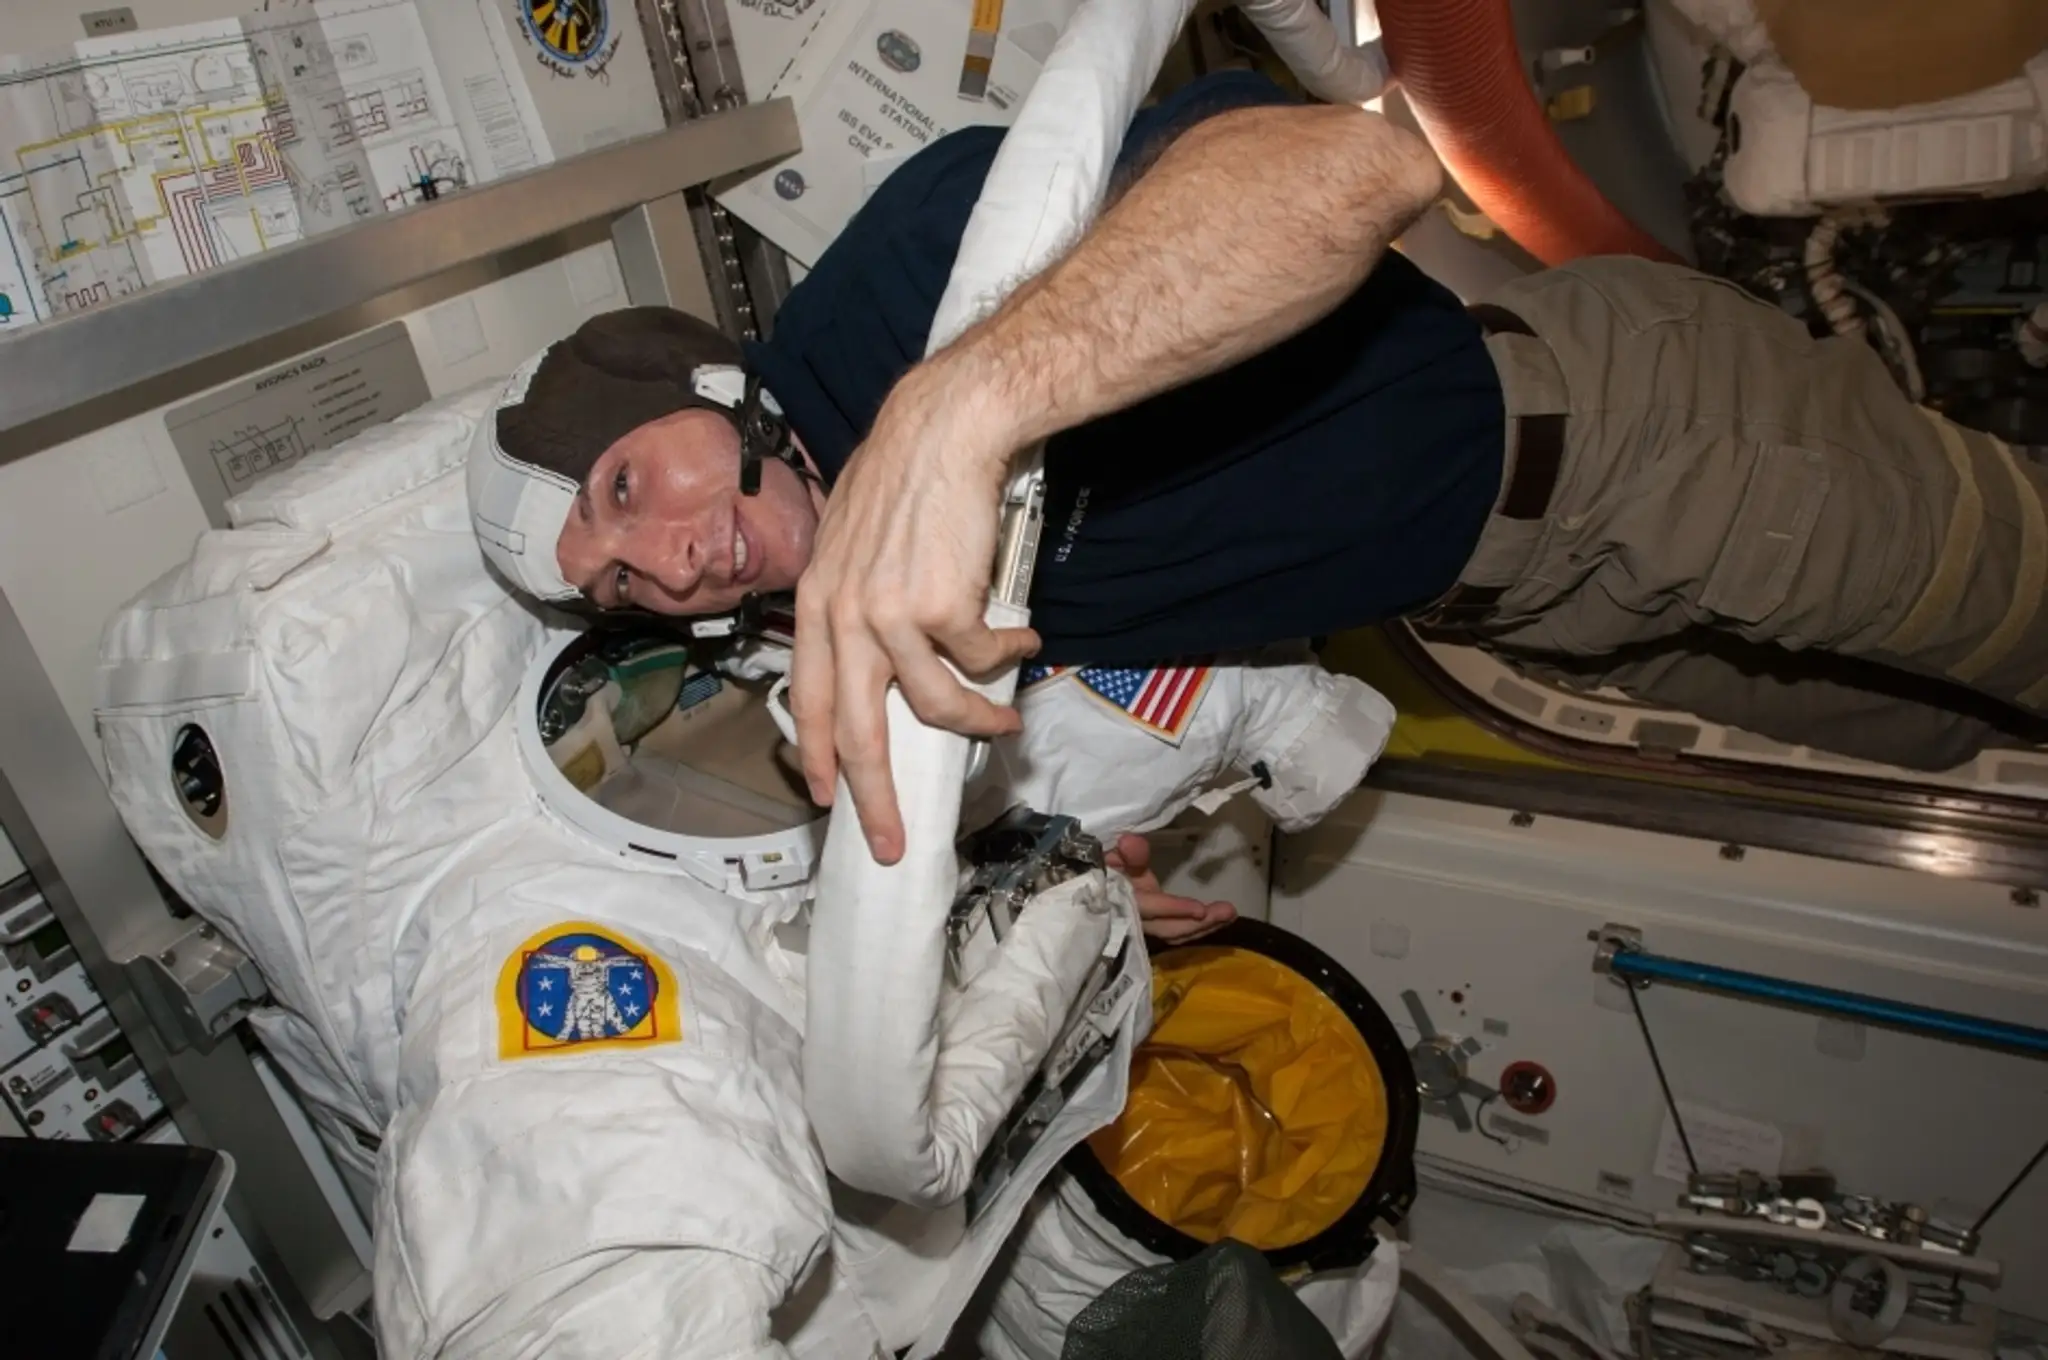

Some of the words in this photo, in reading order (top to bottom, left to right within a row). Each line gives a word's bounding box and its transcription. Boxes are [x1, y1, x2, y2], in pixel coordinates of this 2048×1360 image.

[847, 60, 935, 132] INTERNATIONAL
[879, 103, 928, 143] STATION
[838, 108, 859, 128] ISS
[858, 124, 882, 147] EVA
[1054, 543, 1073, 562] U.S.
[1066, 487, 1091, 535] FORCE
